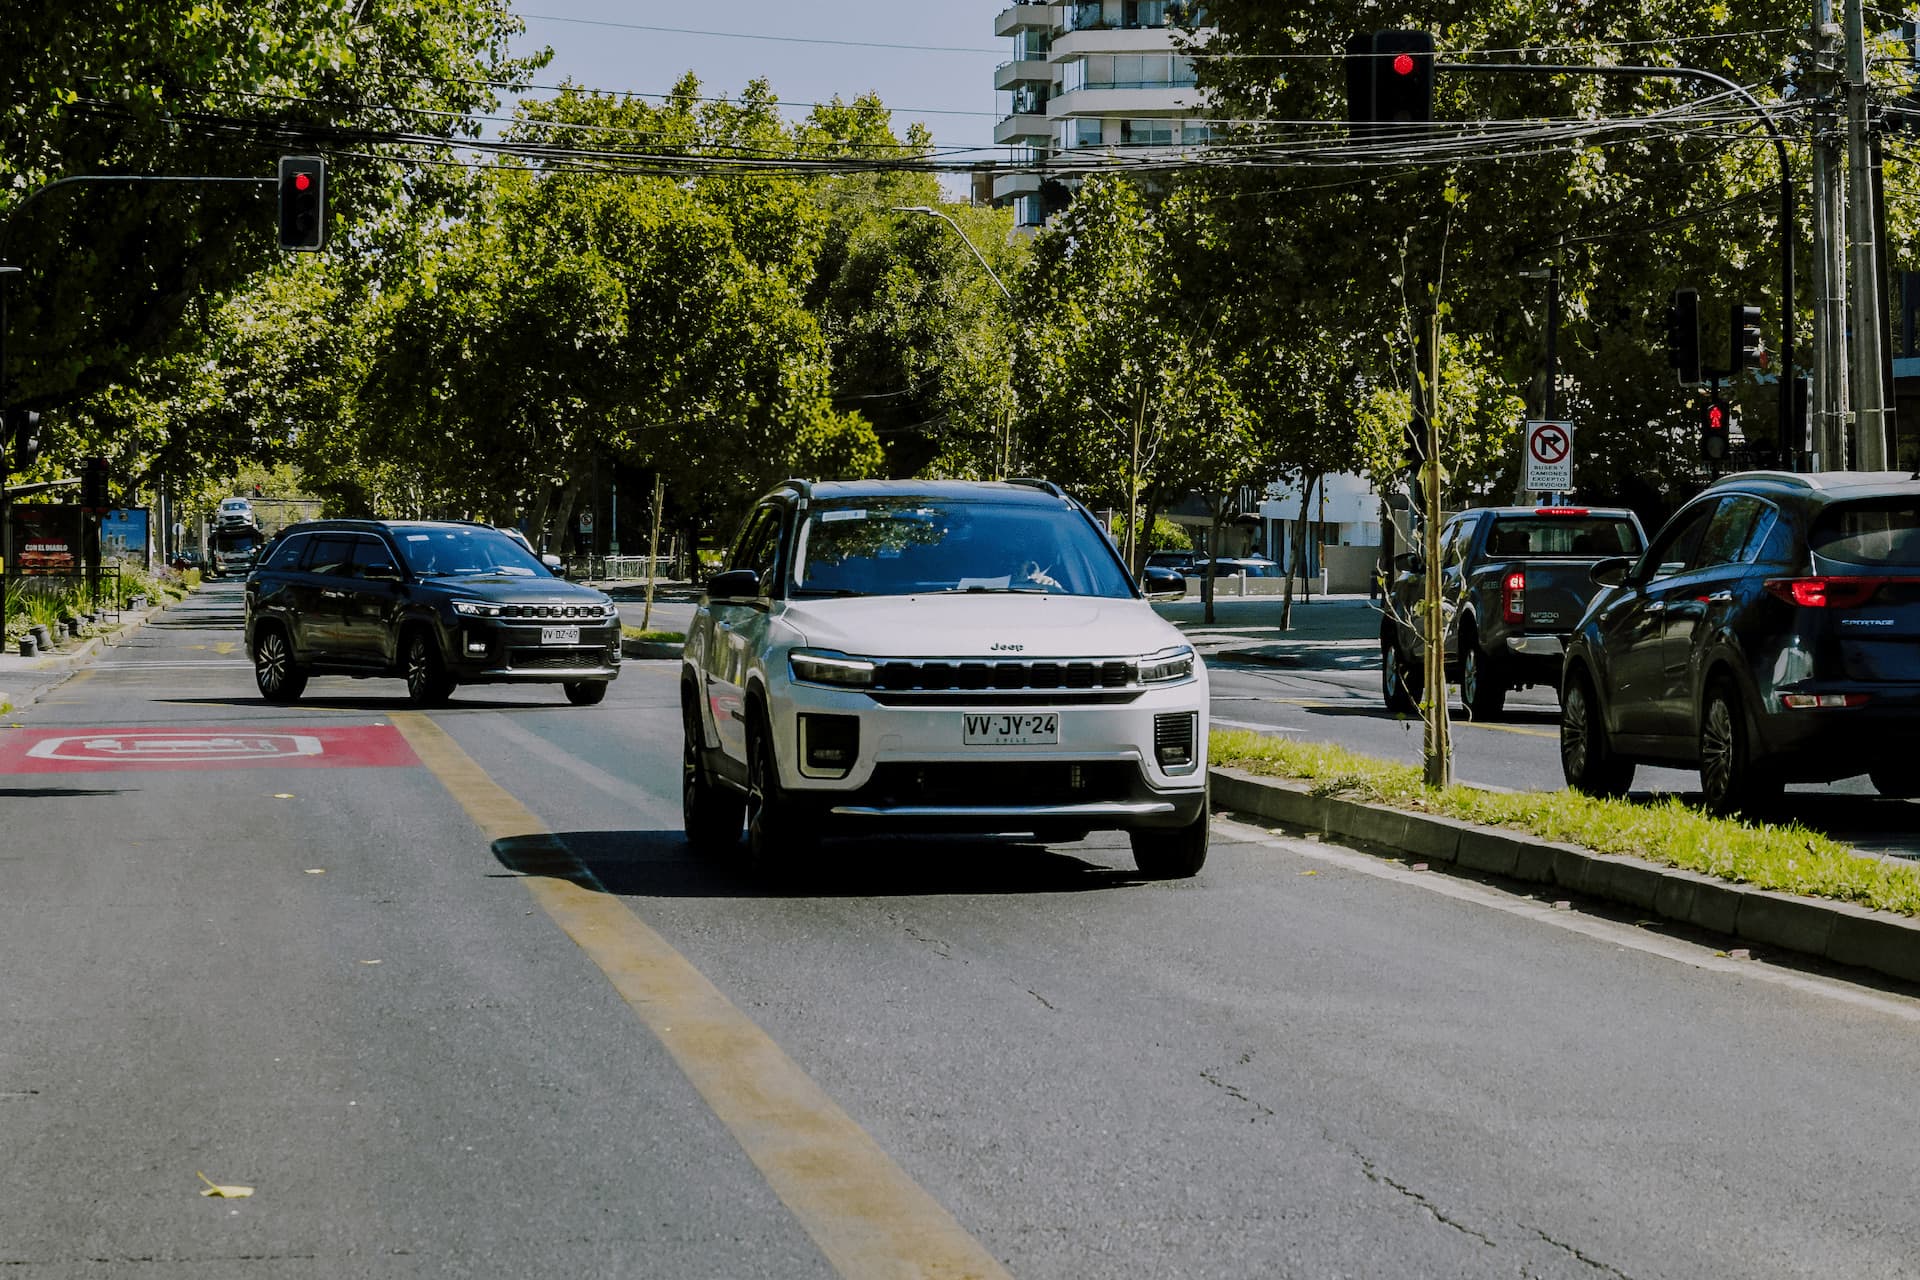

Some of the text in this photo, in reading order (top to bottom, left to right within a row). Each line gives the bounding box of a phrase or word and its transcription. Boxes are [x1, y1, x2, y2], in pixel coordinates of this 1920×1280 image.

[25, 544, 69, 552] CON EL DIABLO
[990, 643, 1024, 652] Jeep
